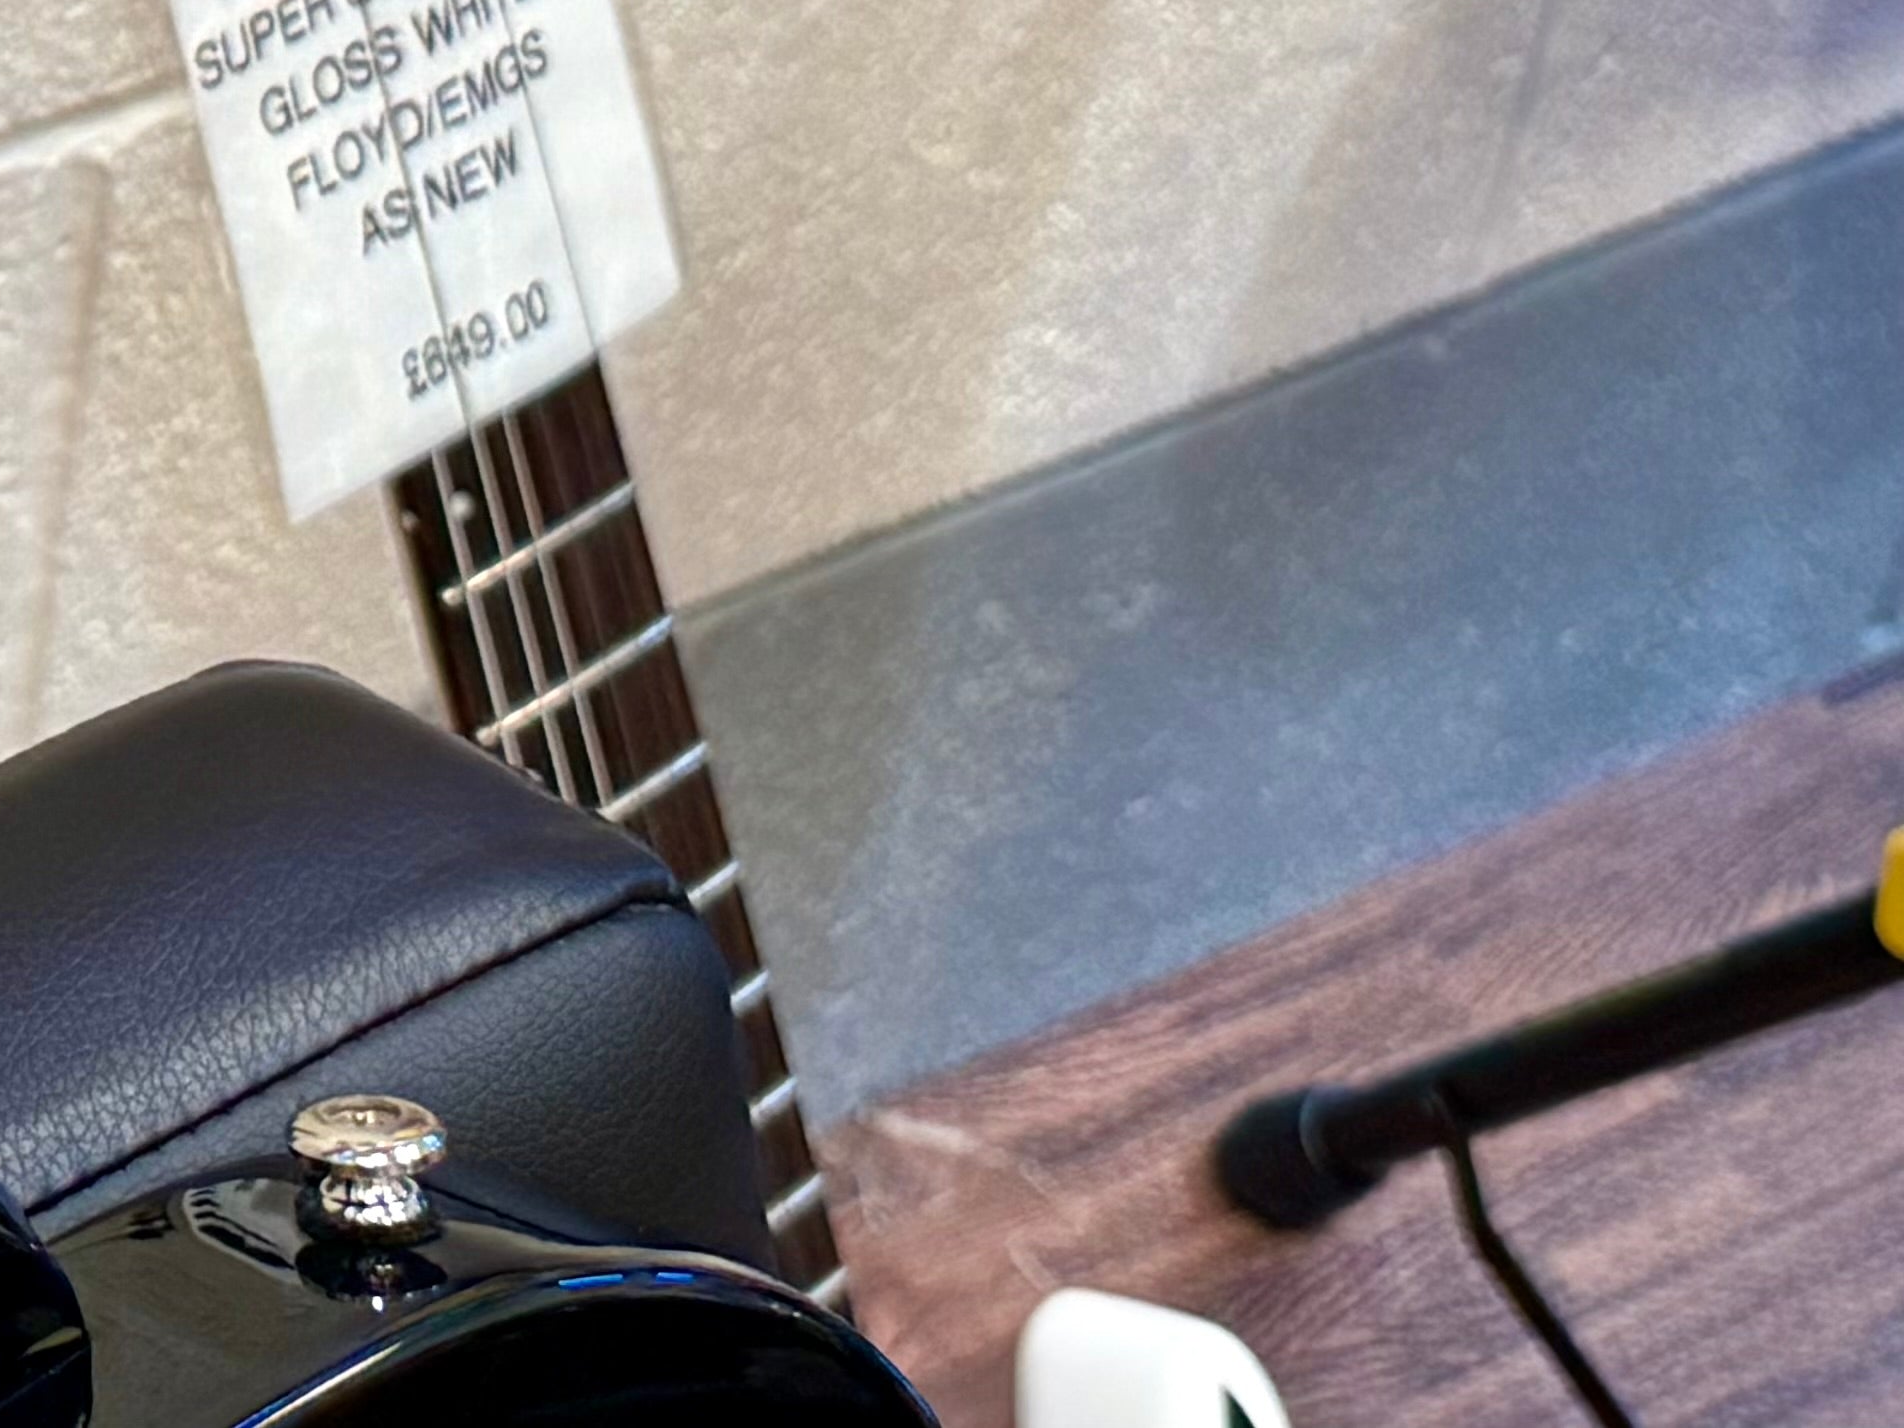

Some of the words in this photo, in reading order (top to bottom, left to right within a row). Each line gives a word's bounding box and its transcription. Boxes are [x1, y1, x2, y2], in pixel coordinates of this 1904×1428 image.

[260, 25, 403, 135] GLOSS
[287, 29, 549, 211] FLOYD/EMGS
[361, 188, 415, 257] AS
[423, 129, 520, 221] NEW
